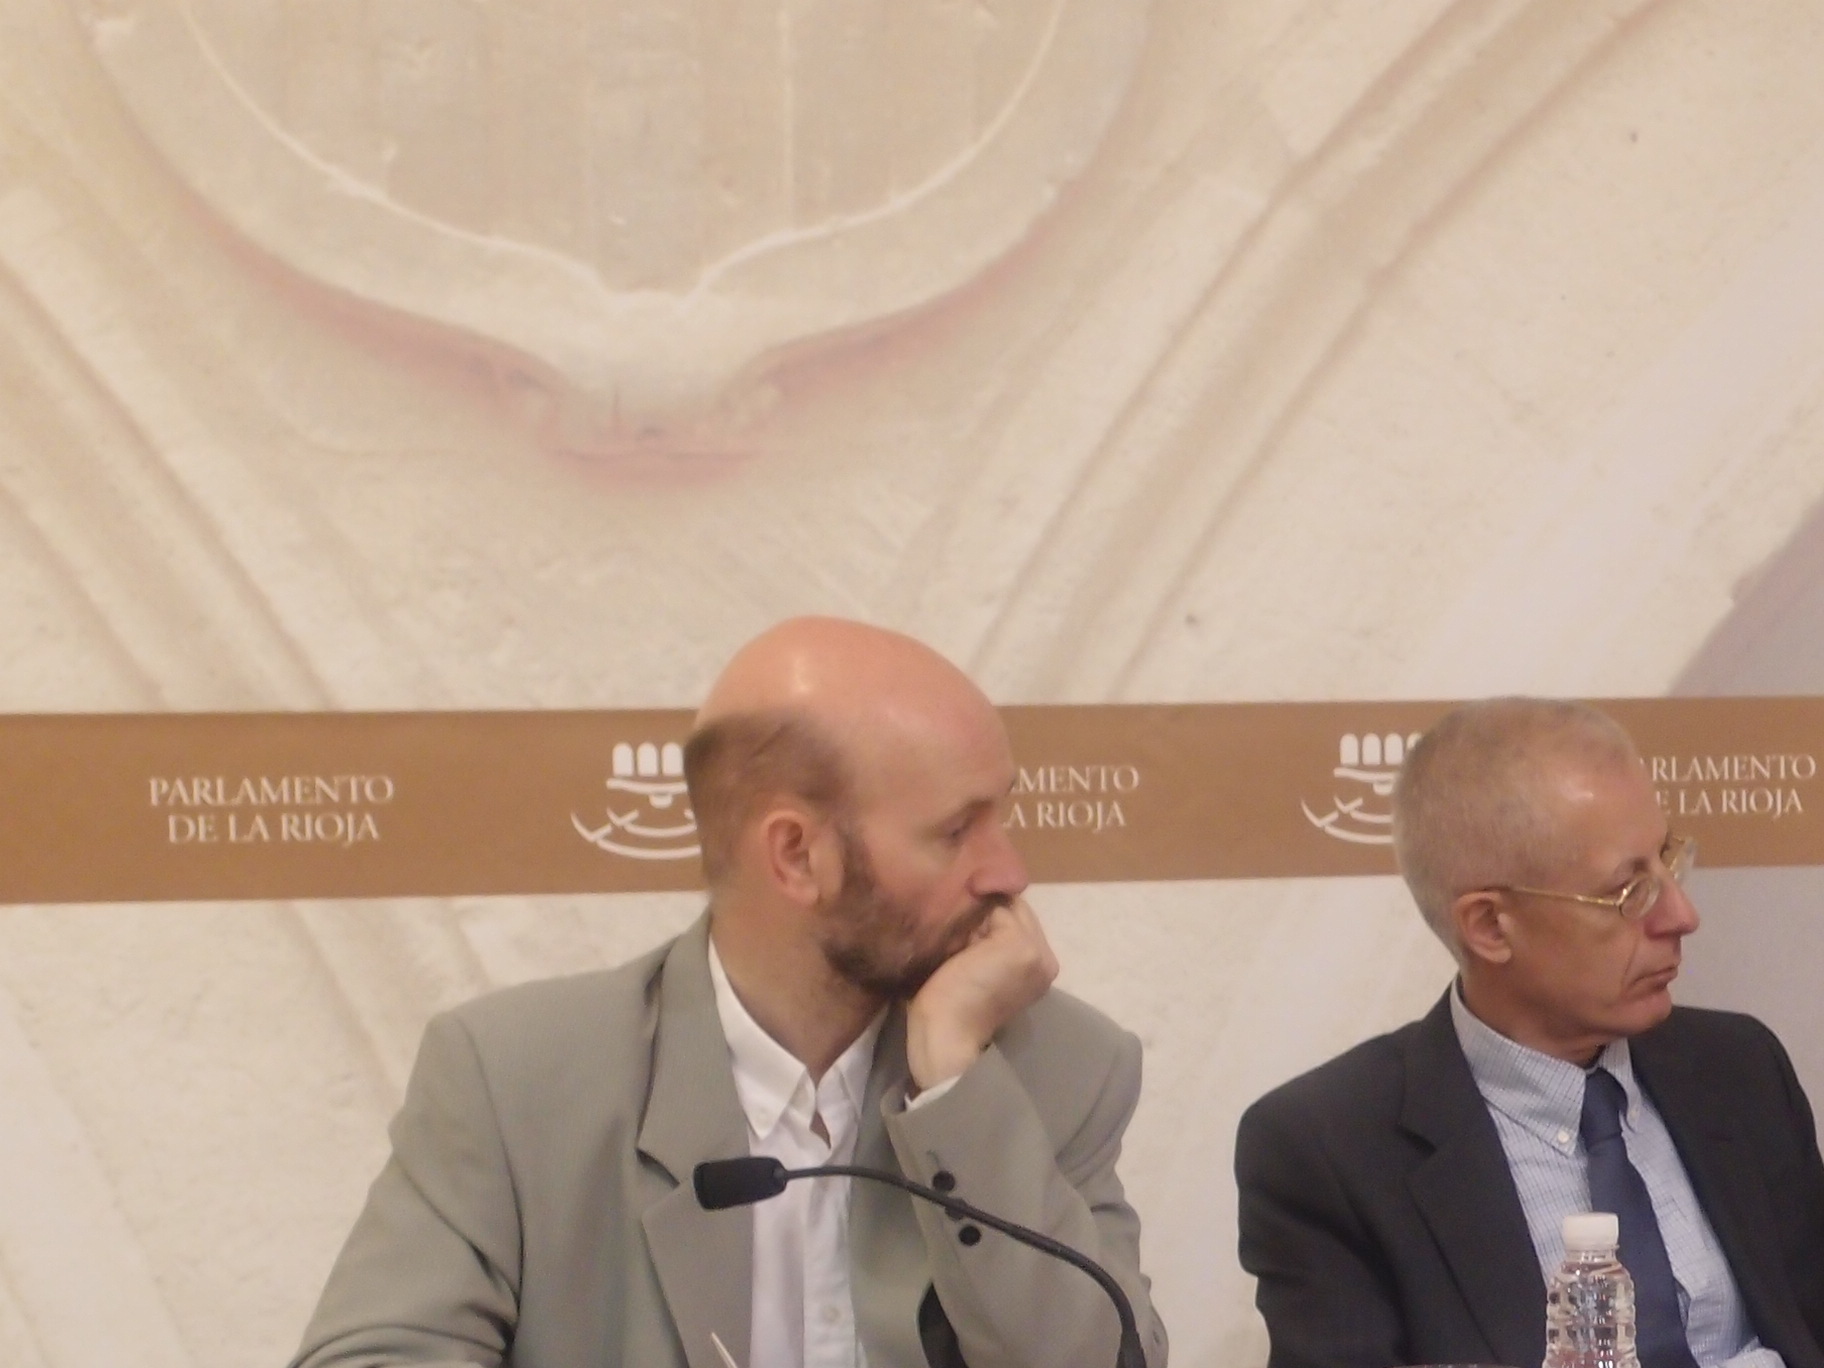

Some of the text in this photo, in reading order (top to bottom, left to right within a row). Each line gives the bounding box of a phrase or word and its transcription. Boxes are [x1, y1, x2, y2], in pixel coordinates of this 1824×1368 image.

[1010, 764, 1140, 794] MENTO
[1639, 753, 1816, 782] RLAMENTO
[149, 774, 395, 806] PARLAMENTO
[1655, 786, 1804, 819] E LA RIOJA
[167, 811, 379, 848] DE LA RIOJA
[1002, 800, 1126, 834] A RIOJA
